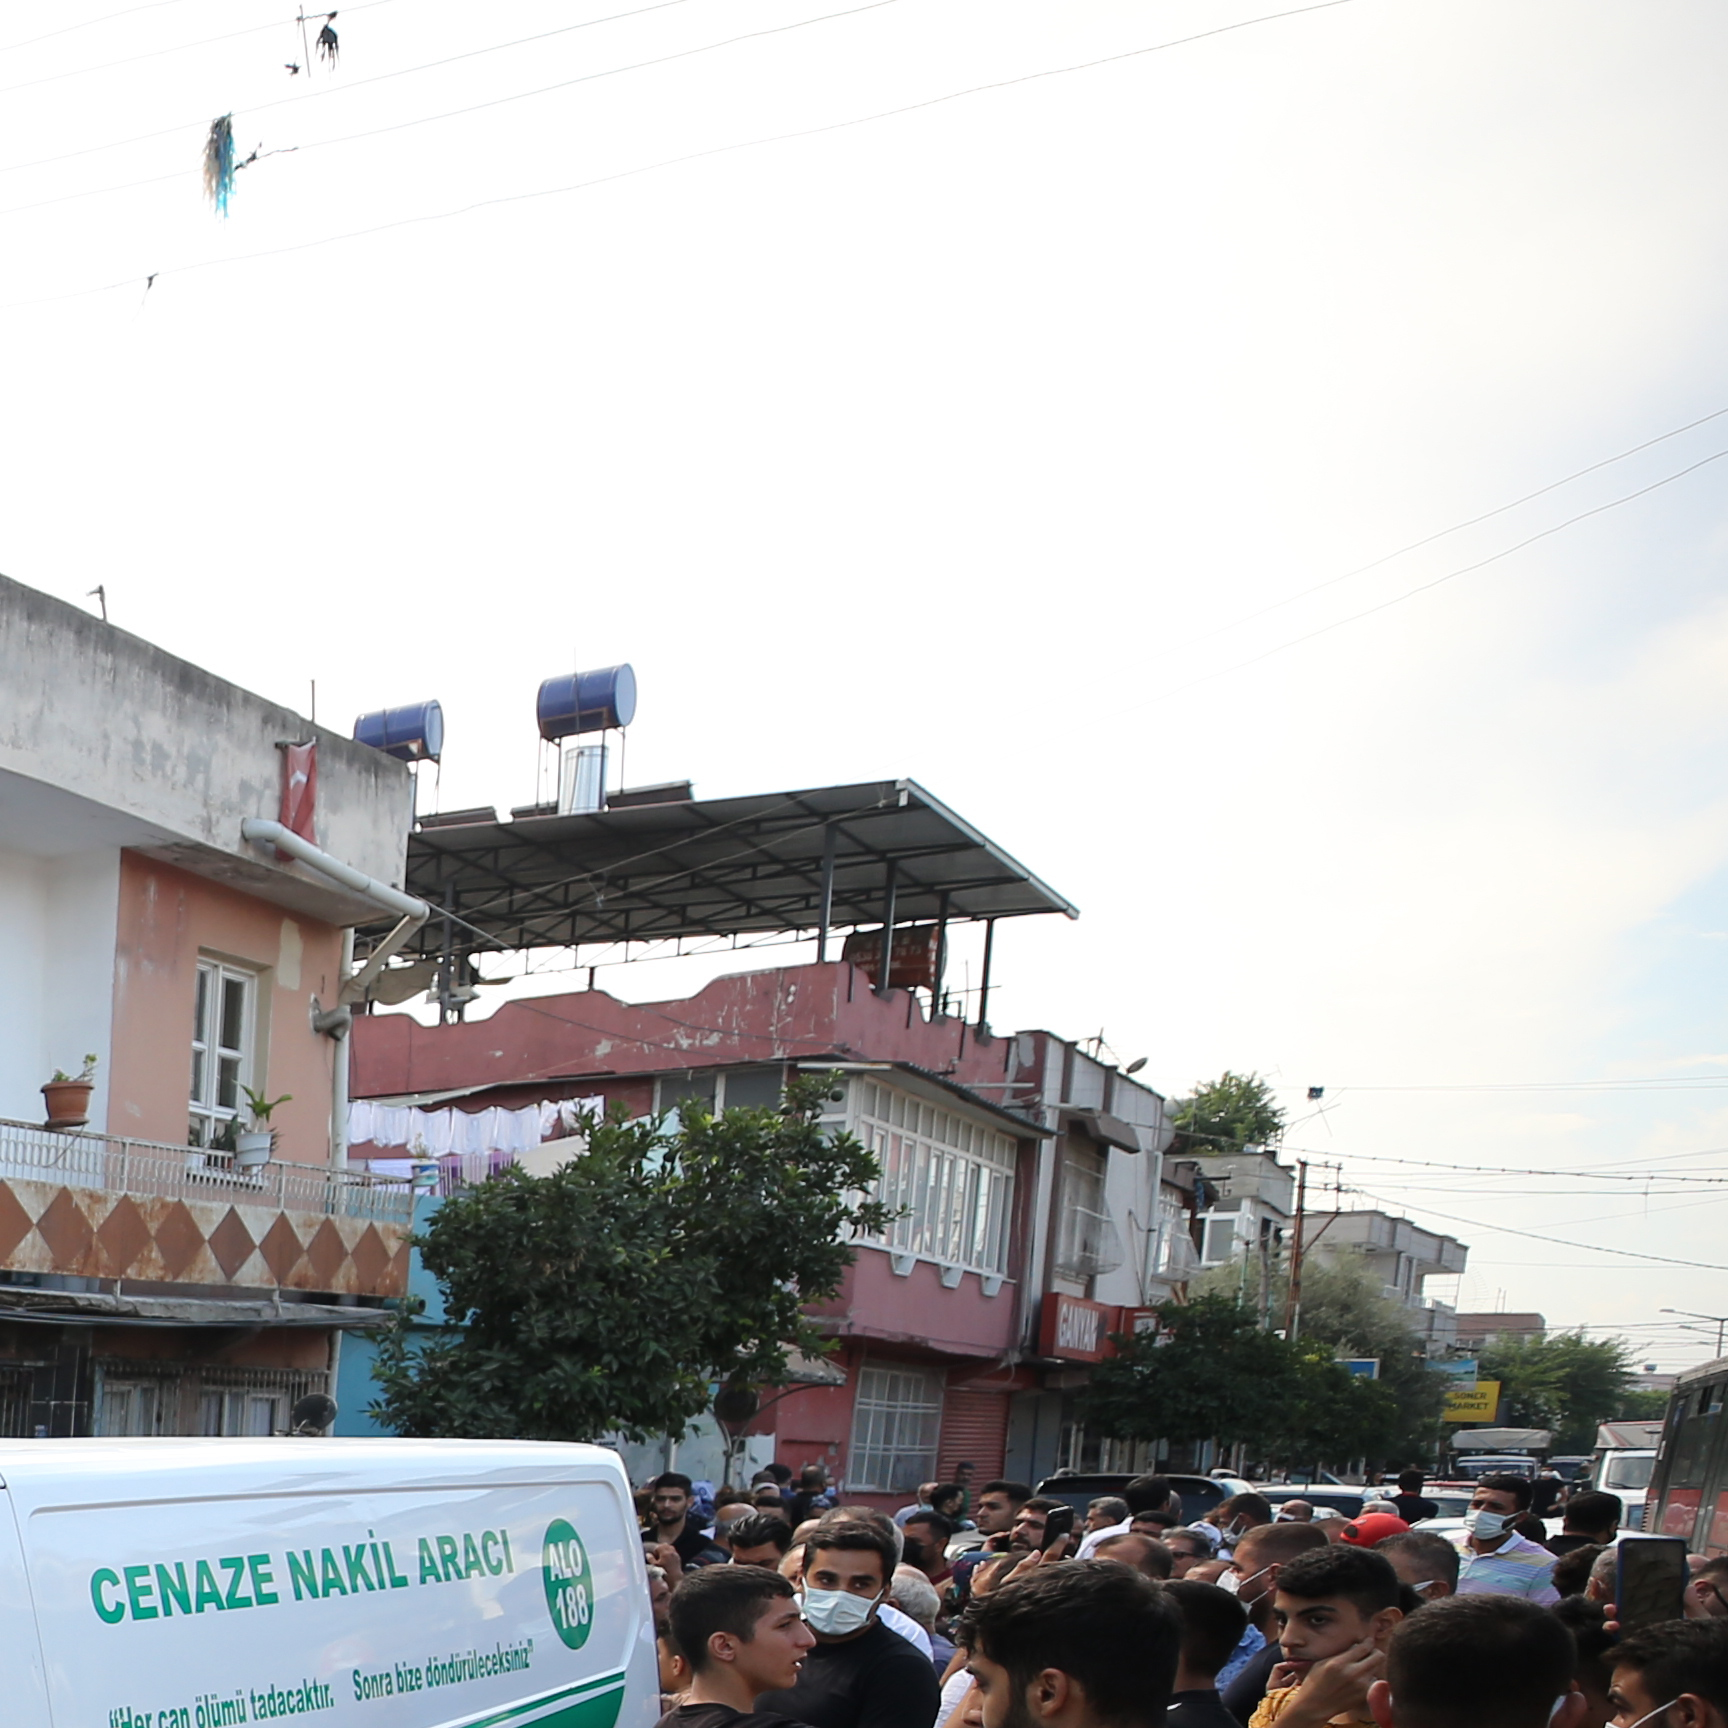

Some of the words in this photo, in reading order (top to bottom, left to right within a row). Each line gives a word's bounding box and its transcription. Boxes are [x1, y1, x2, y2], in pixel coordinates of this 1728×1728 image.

[91, 1553, 280, 1625] CENAZE
[286, 1529, 408, 1601] NAKİL
[419, 1529, 515, 1585] ARACI
[549, 1538, 583, 1581] ALO
[555, 1587, 590, 1630] 188
[250, 1678, 335, 1722] tadacaktır.
[353, 1669, 394, 1702] Sonra
[396, 1662, 423, 1693] bize
